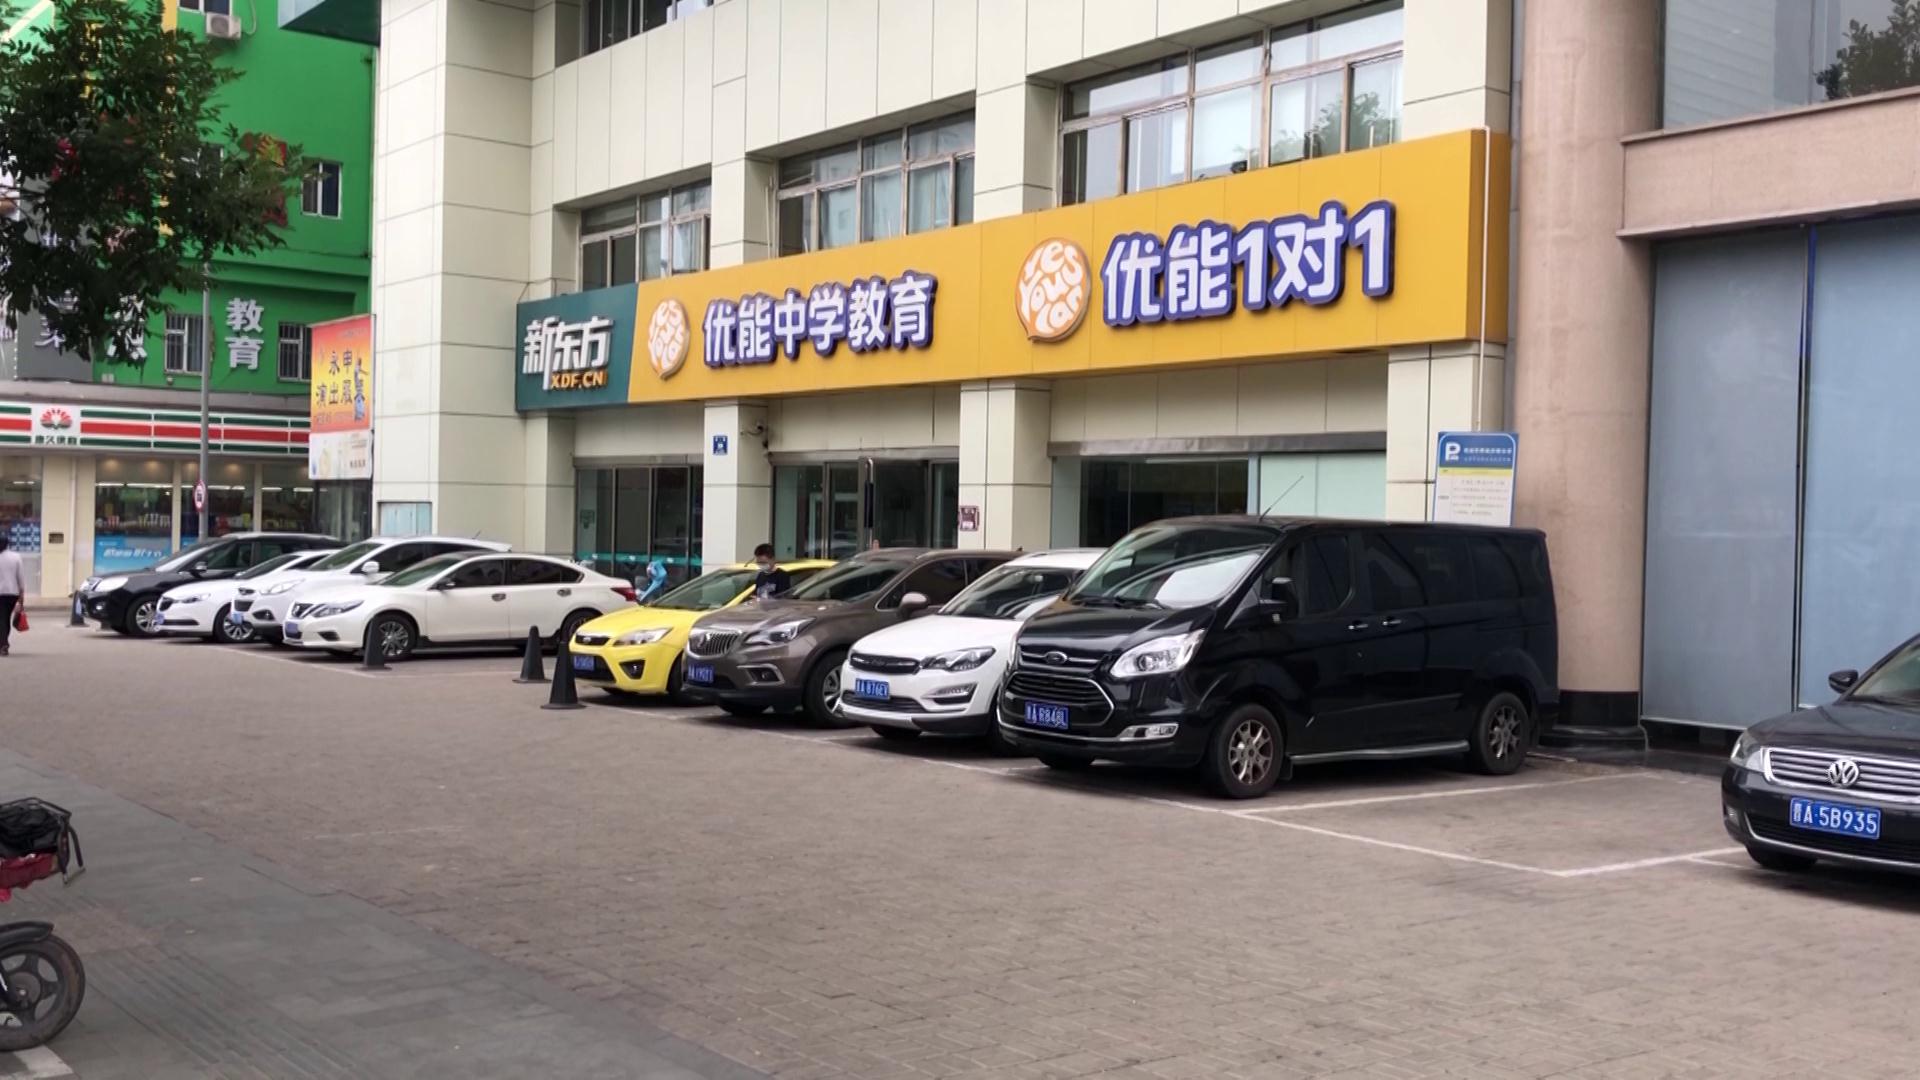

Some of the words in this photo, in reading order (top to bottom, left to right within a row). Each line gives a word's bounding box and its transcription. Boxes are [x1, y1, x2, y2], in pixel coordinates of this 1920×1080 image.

[1104, 204, 1389, 322] 优能1对1
[225, 297, 264, 370] 教育
[523, 316, 611, 391] 新东方
[703, 273, 934, 365] 优能中学教育
[552, 369, 606, 390] XDF.CN
